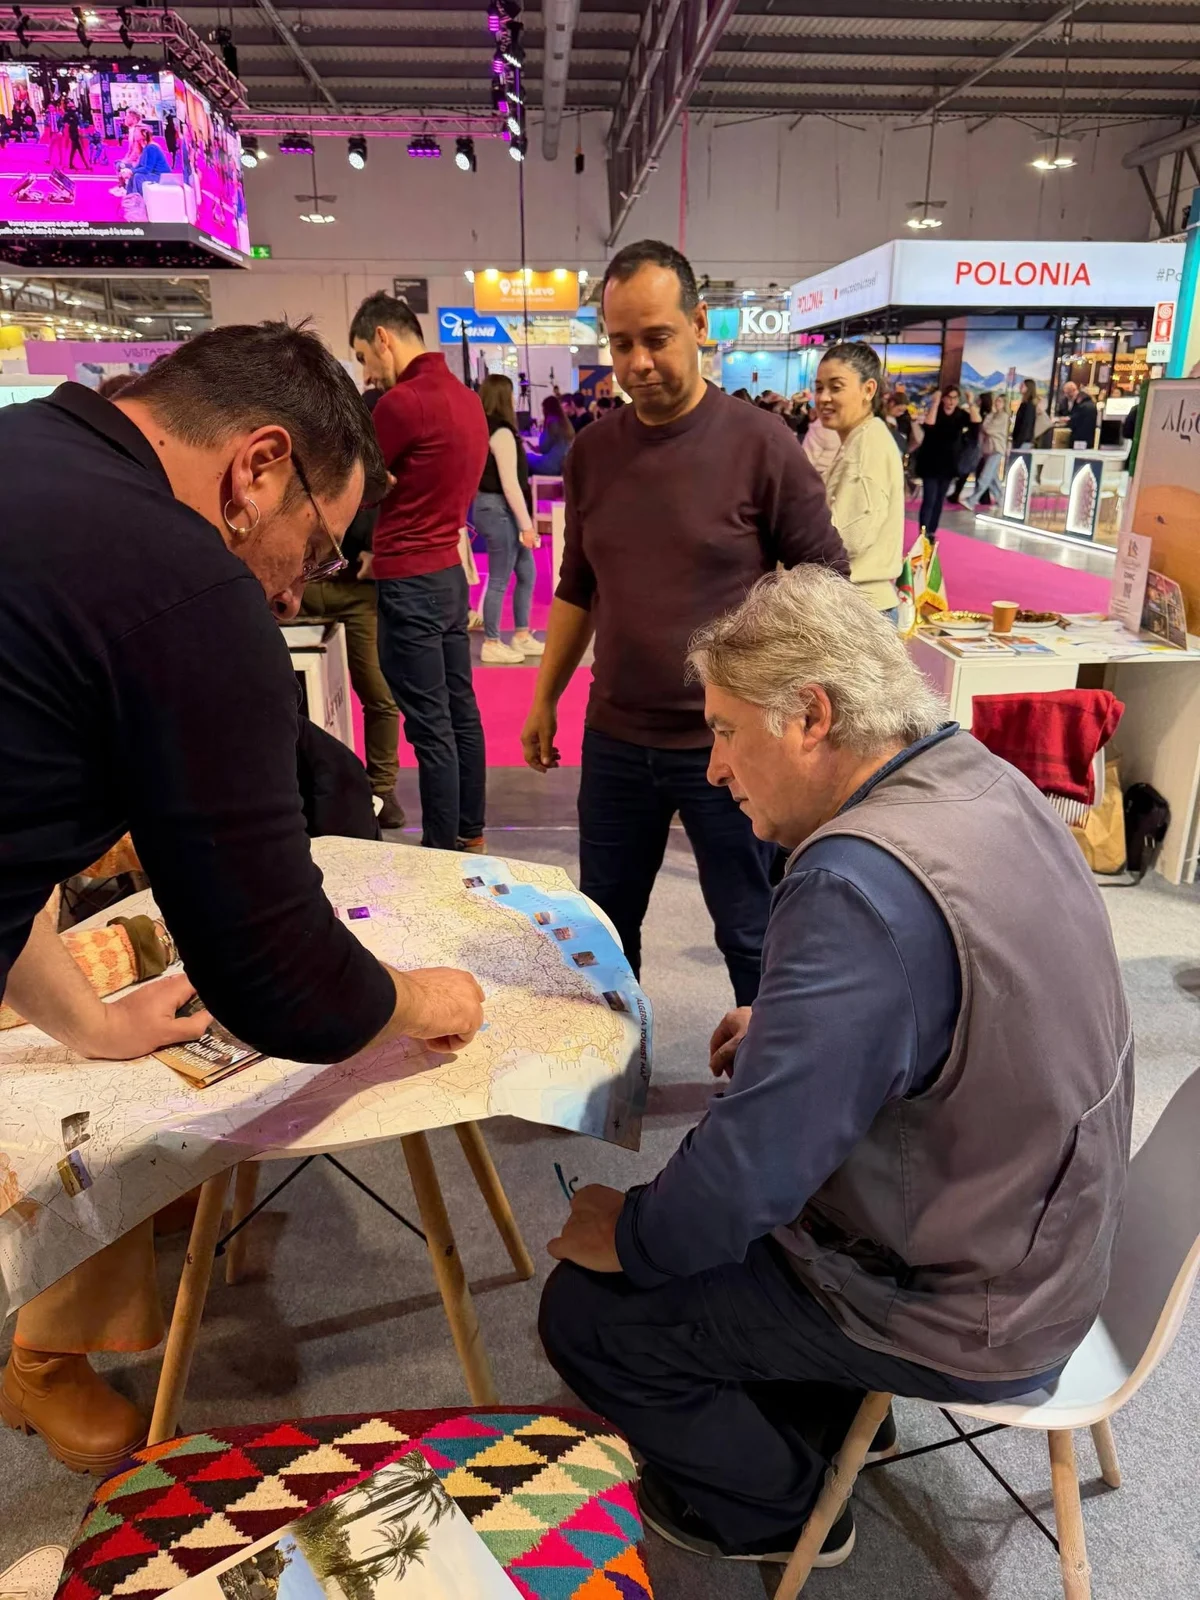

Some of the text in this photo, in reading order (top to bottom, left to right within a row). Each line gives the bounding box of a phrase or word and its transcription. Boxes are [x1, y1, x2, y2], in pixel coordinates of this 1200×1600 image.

[955, 261, 1091, 286] POLONIA
[199, 1033, 248, 1060] ATRIMONIO
[636, 997, 649, 1082] ALGERIA TOURIST MAP
